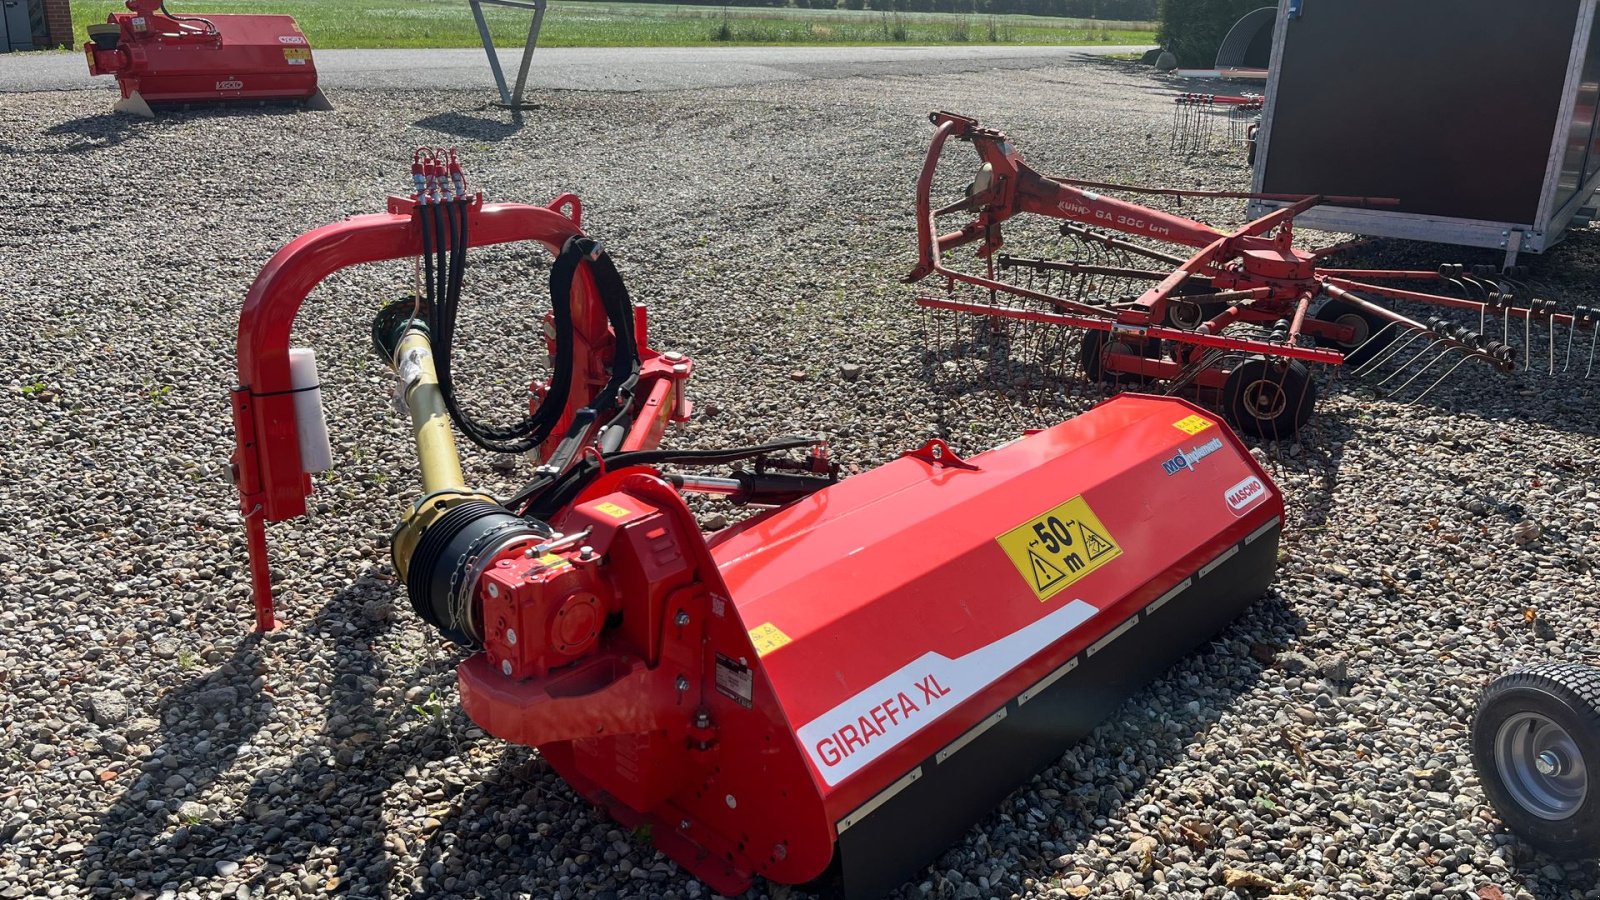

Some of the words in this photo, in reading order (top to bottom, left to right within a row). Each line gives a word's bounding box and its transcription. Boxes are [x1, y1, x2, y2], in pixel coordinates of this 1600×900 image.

[1058, 201, 1085, 215] KUHN
[1095, 209, 1113, 221] GA
[1117, 215, 1145, 229] 300
[1228, 480, 1261, 506] MASCHIO
[1032, 516, 1073, 554] 50
[1064, 551, 1085, 573] m
[815, 692, 920, 767] GIRAFFA
[914, 674, 951, 705] XL
